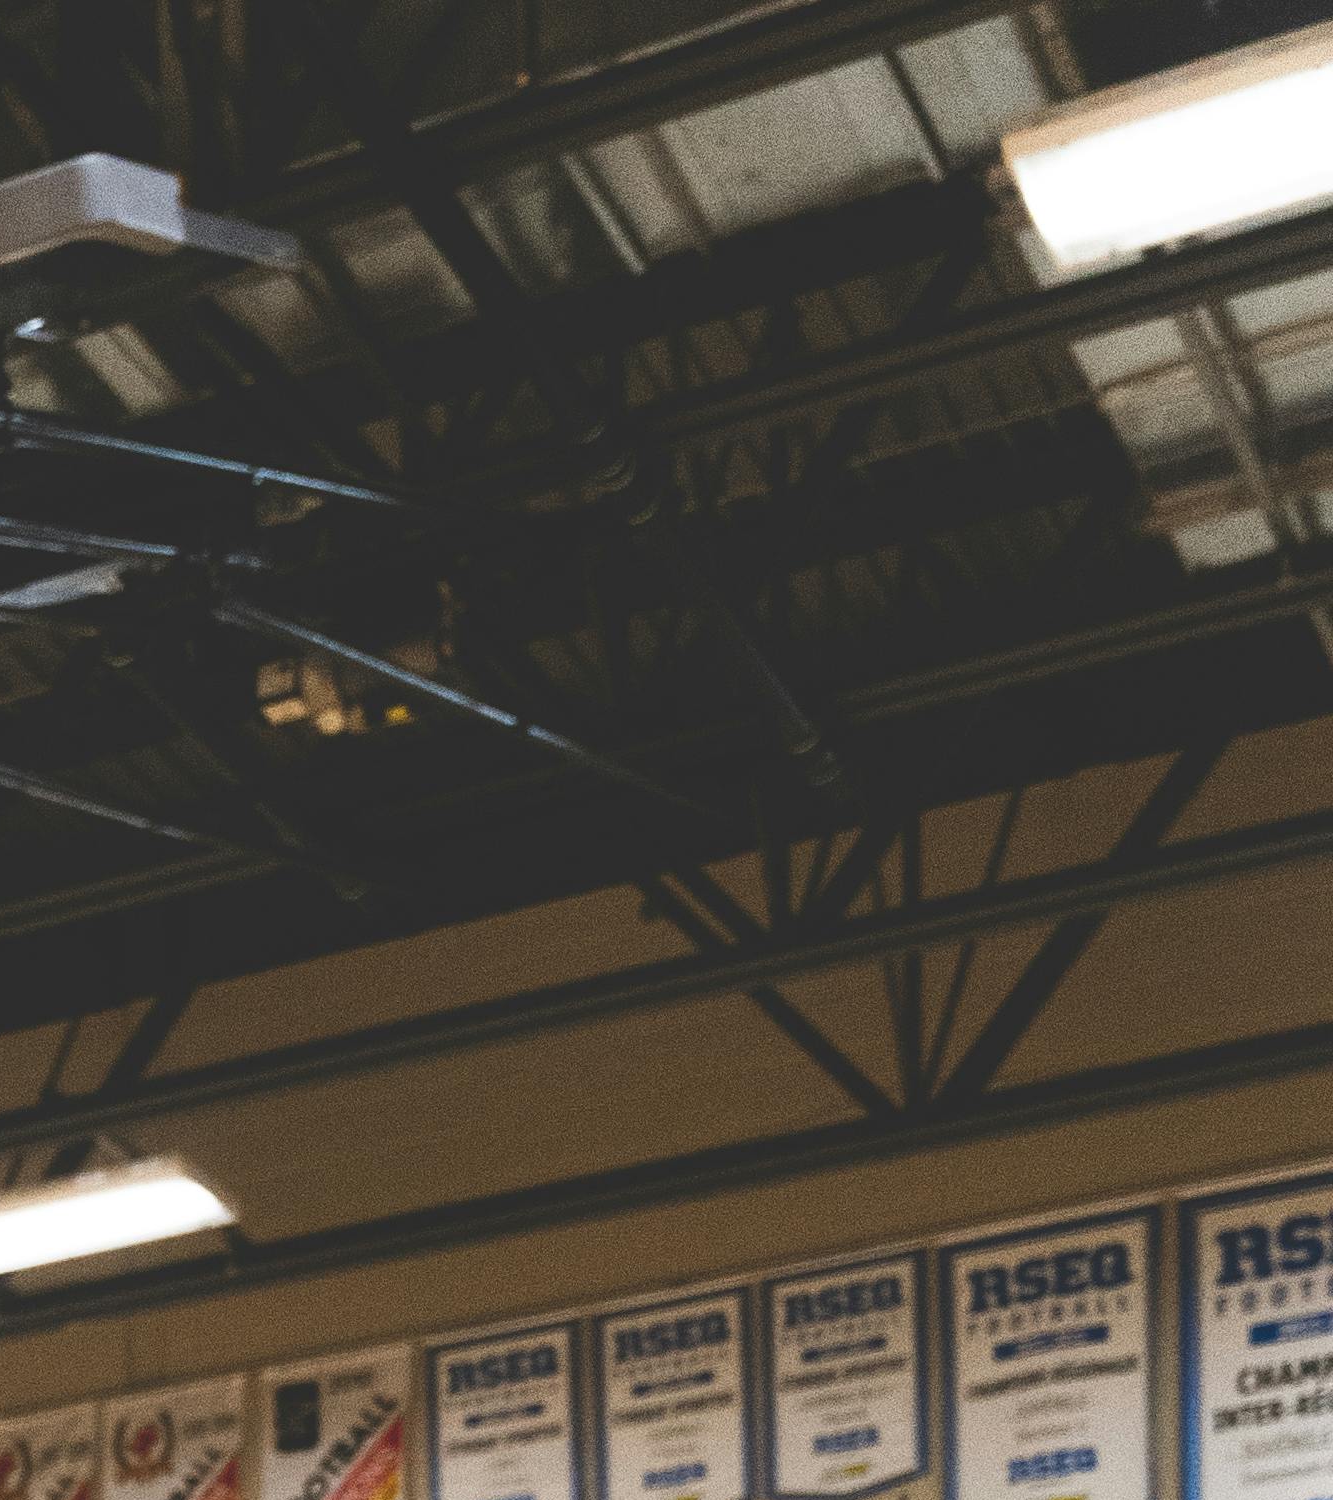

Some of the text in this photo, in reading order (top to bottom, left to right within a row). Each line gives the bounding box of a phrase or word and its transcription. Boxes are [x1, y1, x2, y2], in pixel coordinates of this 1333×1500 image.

[1216, 1211, 1333, 1286] RS
[784, 1276, 902, 1327] RSEQ
[968, 1243, 1132, 1313] RSEQ
[614, 1311, 731, 1363] RSEQ
[447, 1346, 559, 1395] RSEQ
